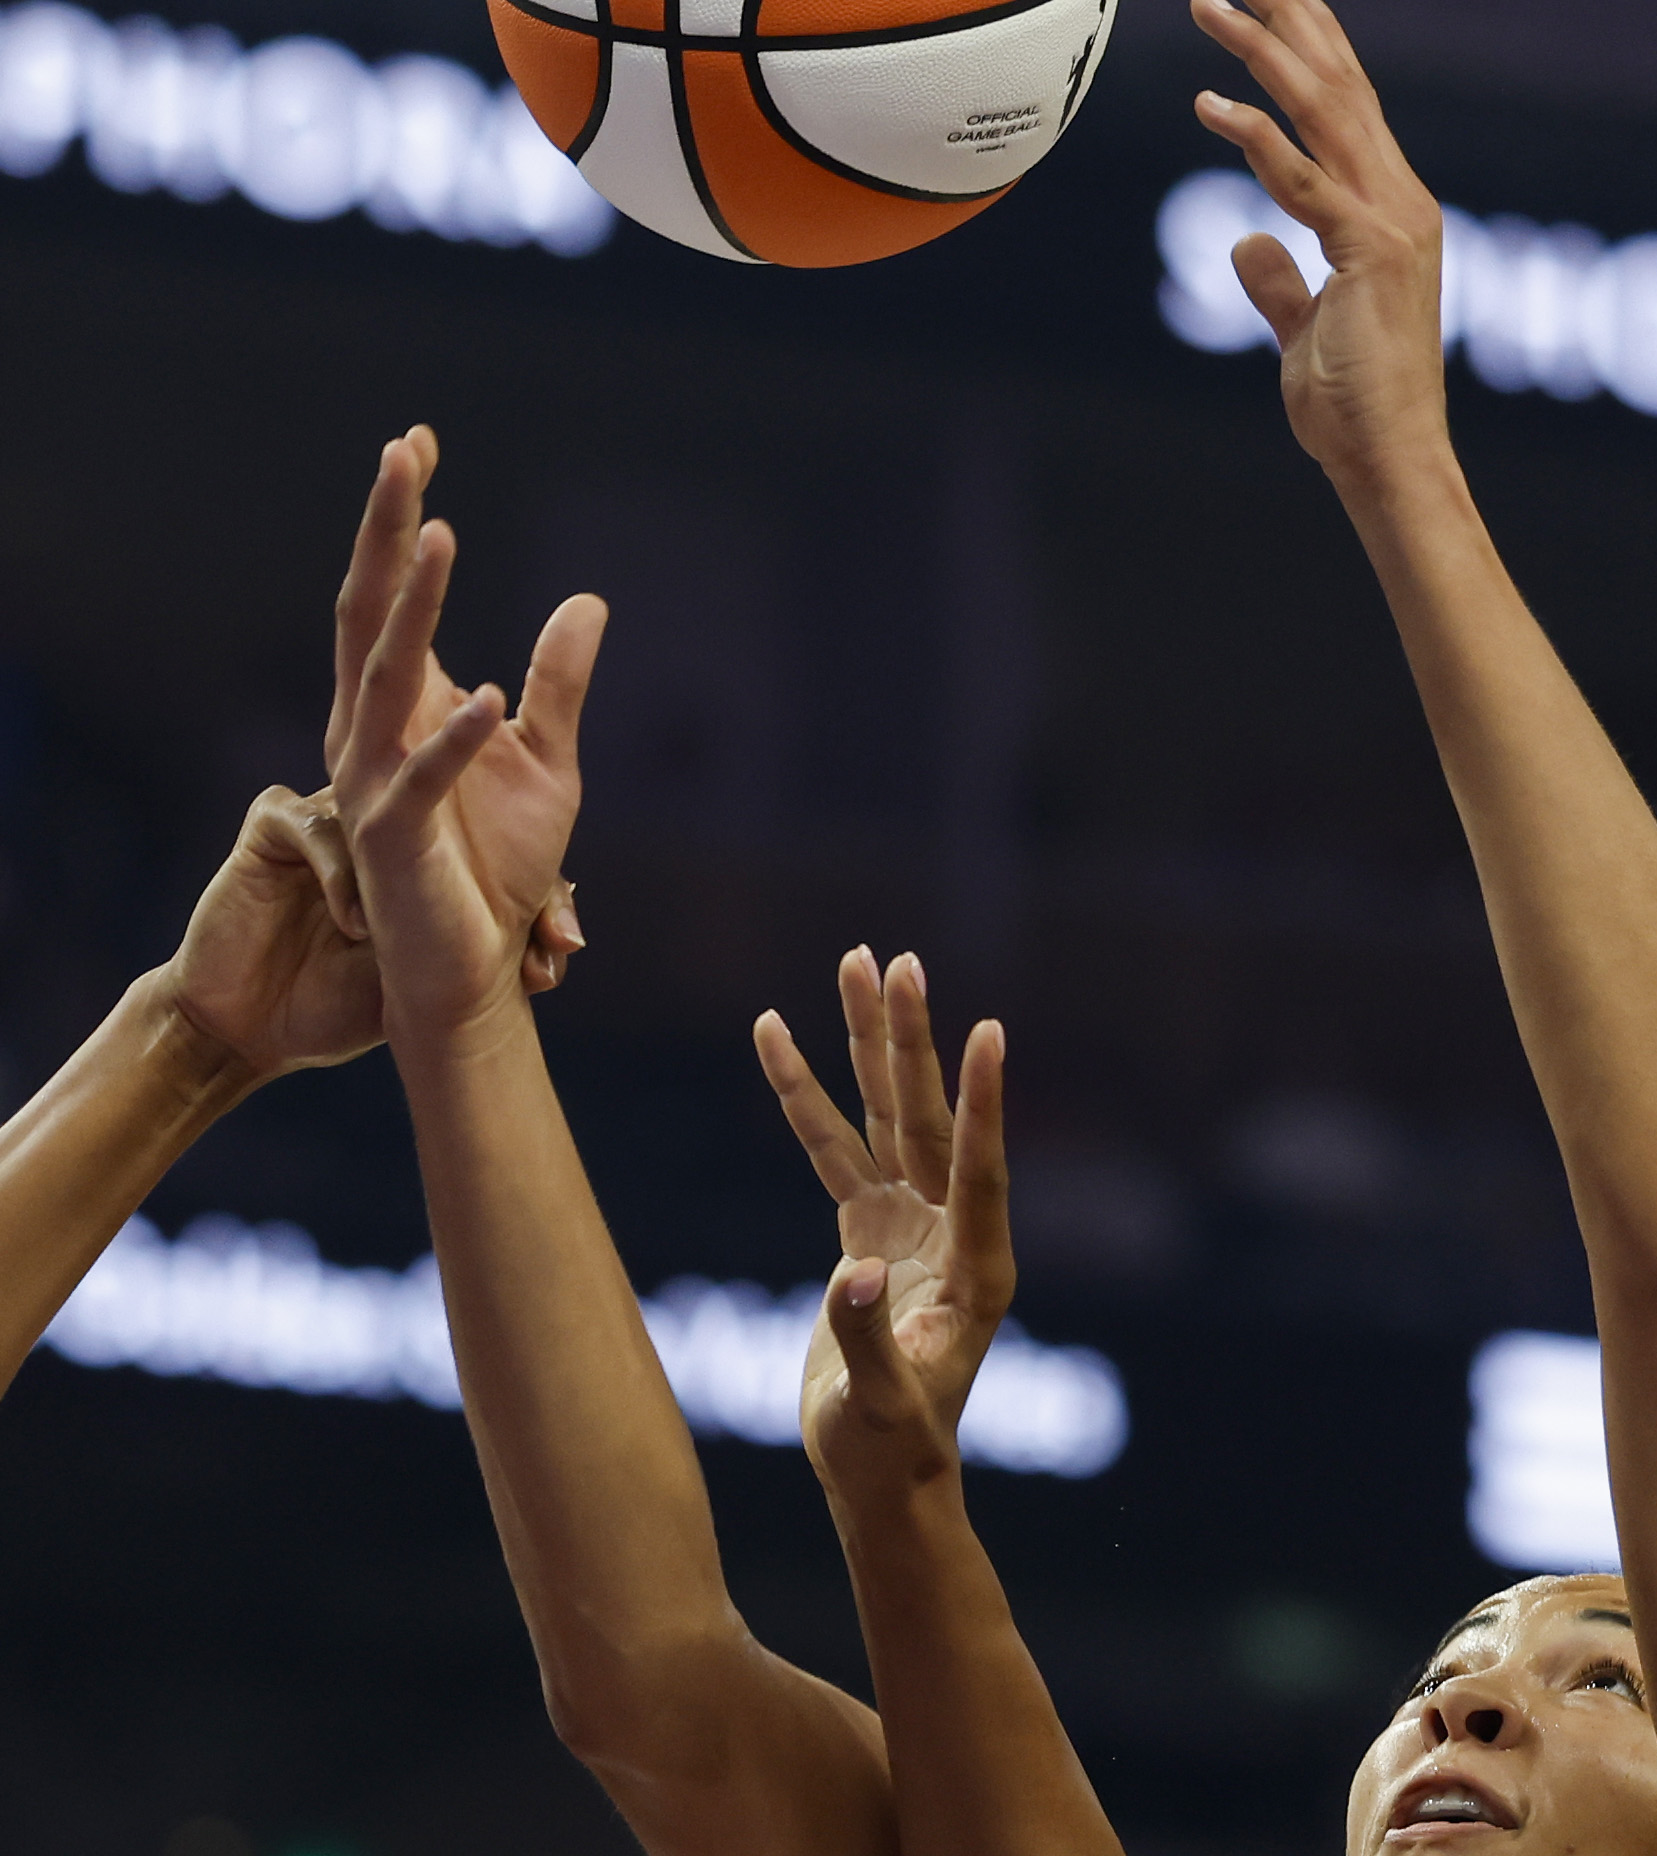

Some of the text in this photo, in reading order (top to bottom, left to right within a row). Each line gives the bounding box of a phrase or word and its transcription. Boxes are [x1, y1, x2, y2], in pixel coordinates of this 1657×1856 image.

[966, 104, 1041, 126] OFFICIAL
[947, 119, 1042, 143] GAME BALL
